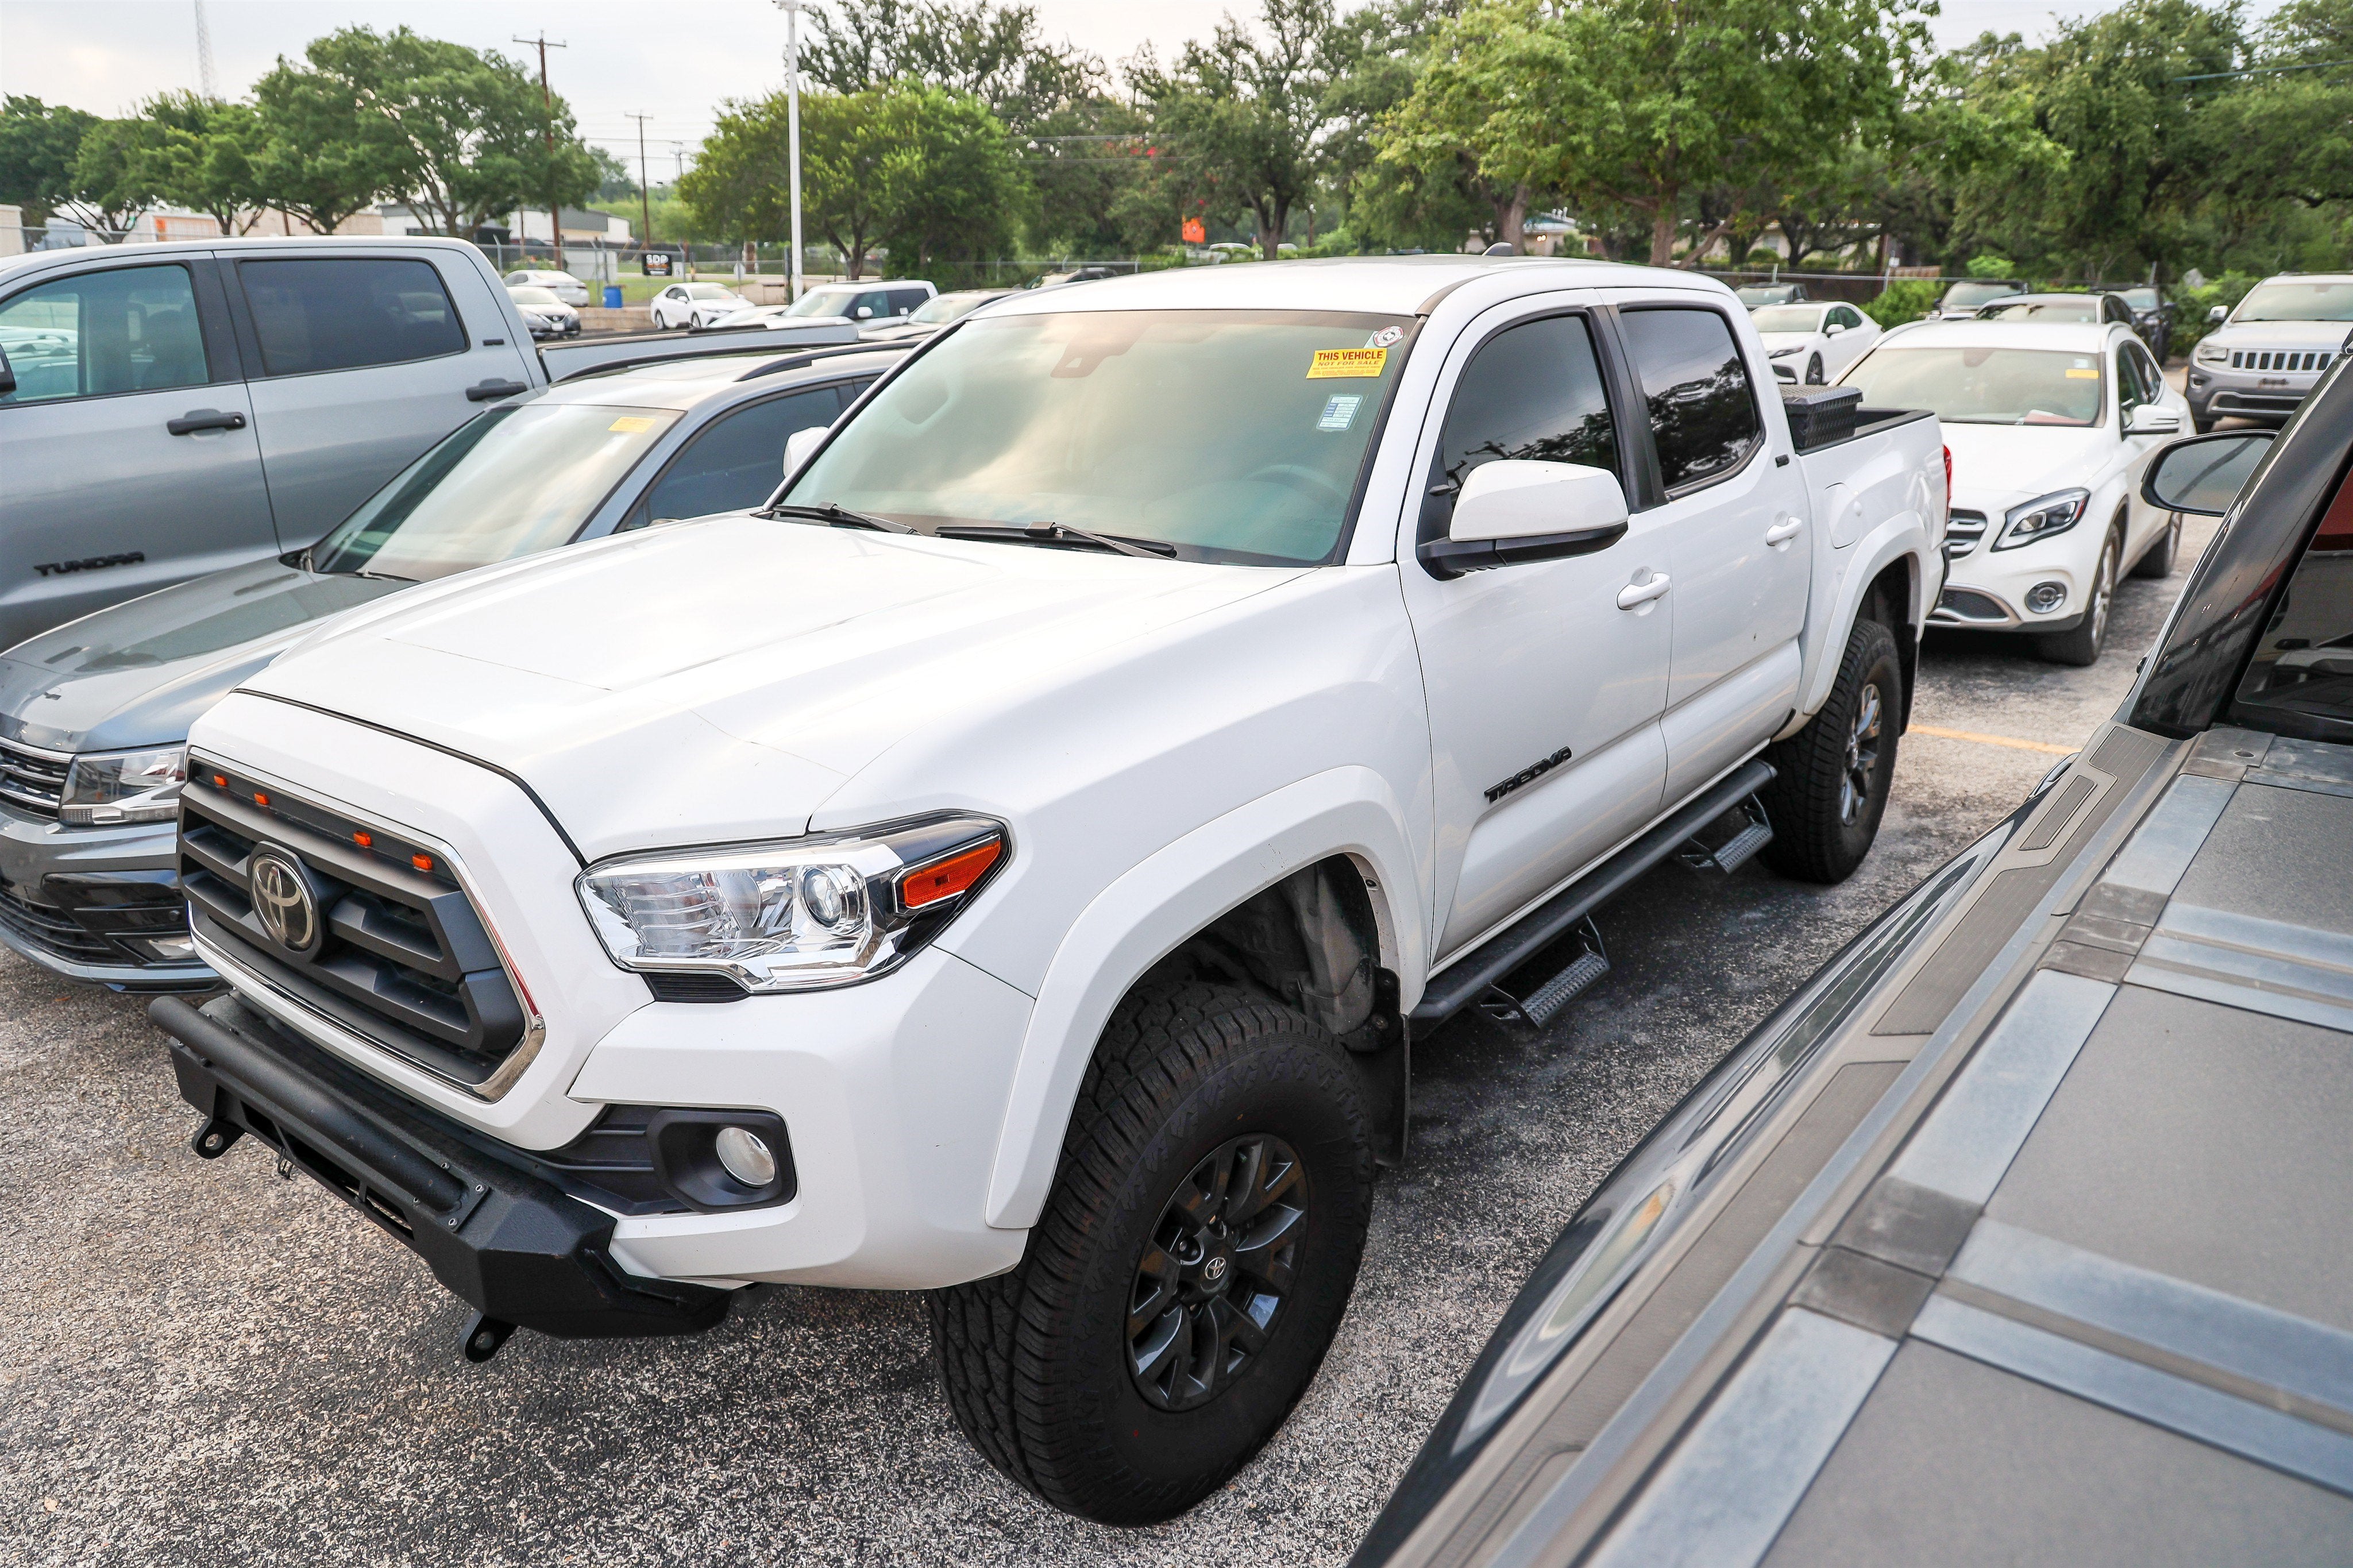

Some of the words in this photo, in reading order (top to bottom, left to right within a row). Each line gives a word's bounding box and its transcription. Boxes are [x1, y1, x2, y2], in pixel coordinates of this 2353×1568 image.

[646, 254, 669, 264] SDP
[1318, 352, 1339, 360] THIS
[1342, 351, 1383, 360] VEHICLE
[33, 551, 145, 576] TUNDRA
[1484, 746, 1573, 804] TACOMA
